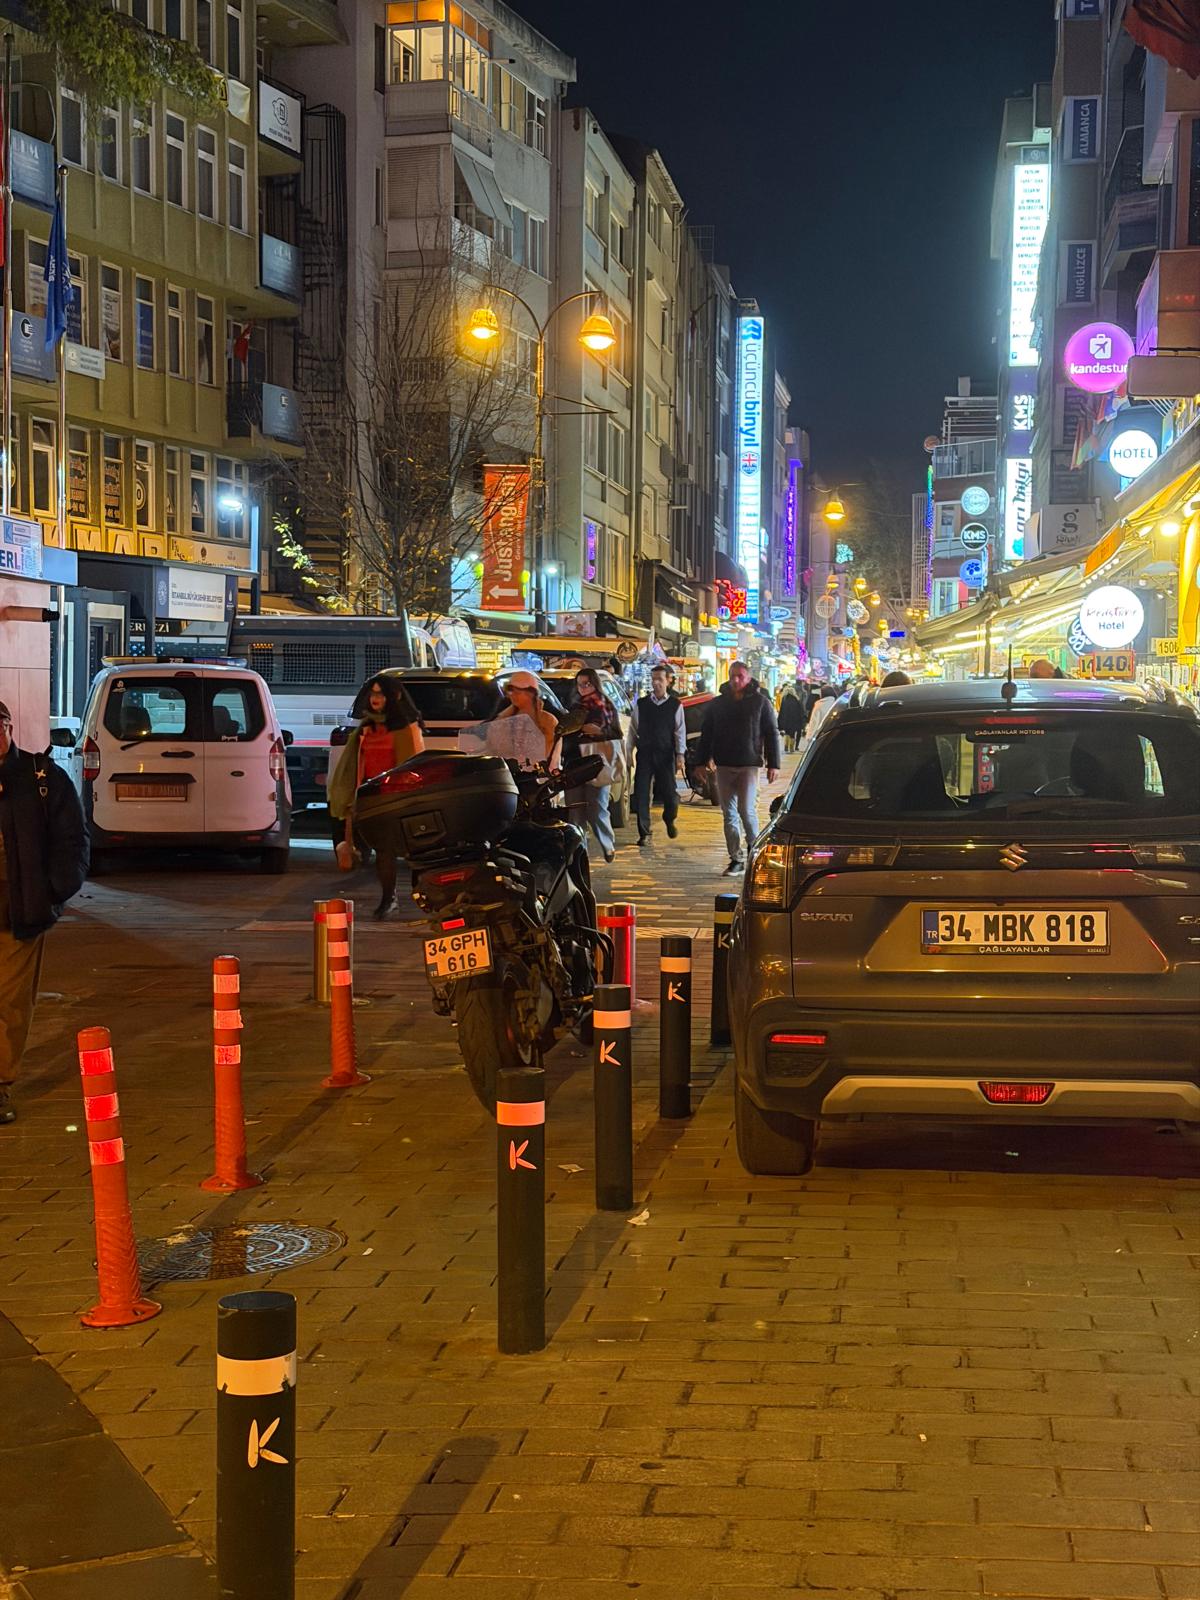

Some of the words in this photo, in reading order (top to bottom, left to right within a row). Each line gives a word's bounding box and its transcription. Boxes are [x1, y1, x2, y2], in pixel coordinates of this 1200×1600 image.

[1079, 103, 1091, 155] ALMANCA
[1013, 394, 1029, 431] KMS
[1113, 448, 1154, 459] HOTEL
[963, 530, 986, 540] KMS
[1098, 621, 1125, 630] Hotel
[800, 912, 854, 922] SUZUKI
[940, 914, 972, 942] 34
[983, 914, 1035, 942] MBK
[1046, 914, 1096, 943] 818
[926, 930, 938, 940] TR
[427, 940, 447, 957] 34
[450, 931, 486, 952] GPH
[978, 945, 1050, 954] ÇAĞLAYANLAR
[447, 952, 477, 972] 616
